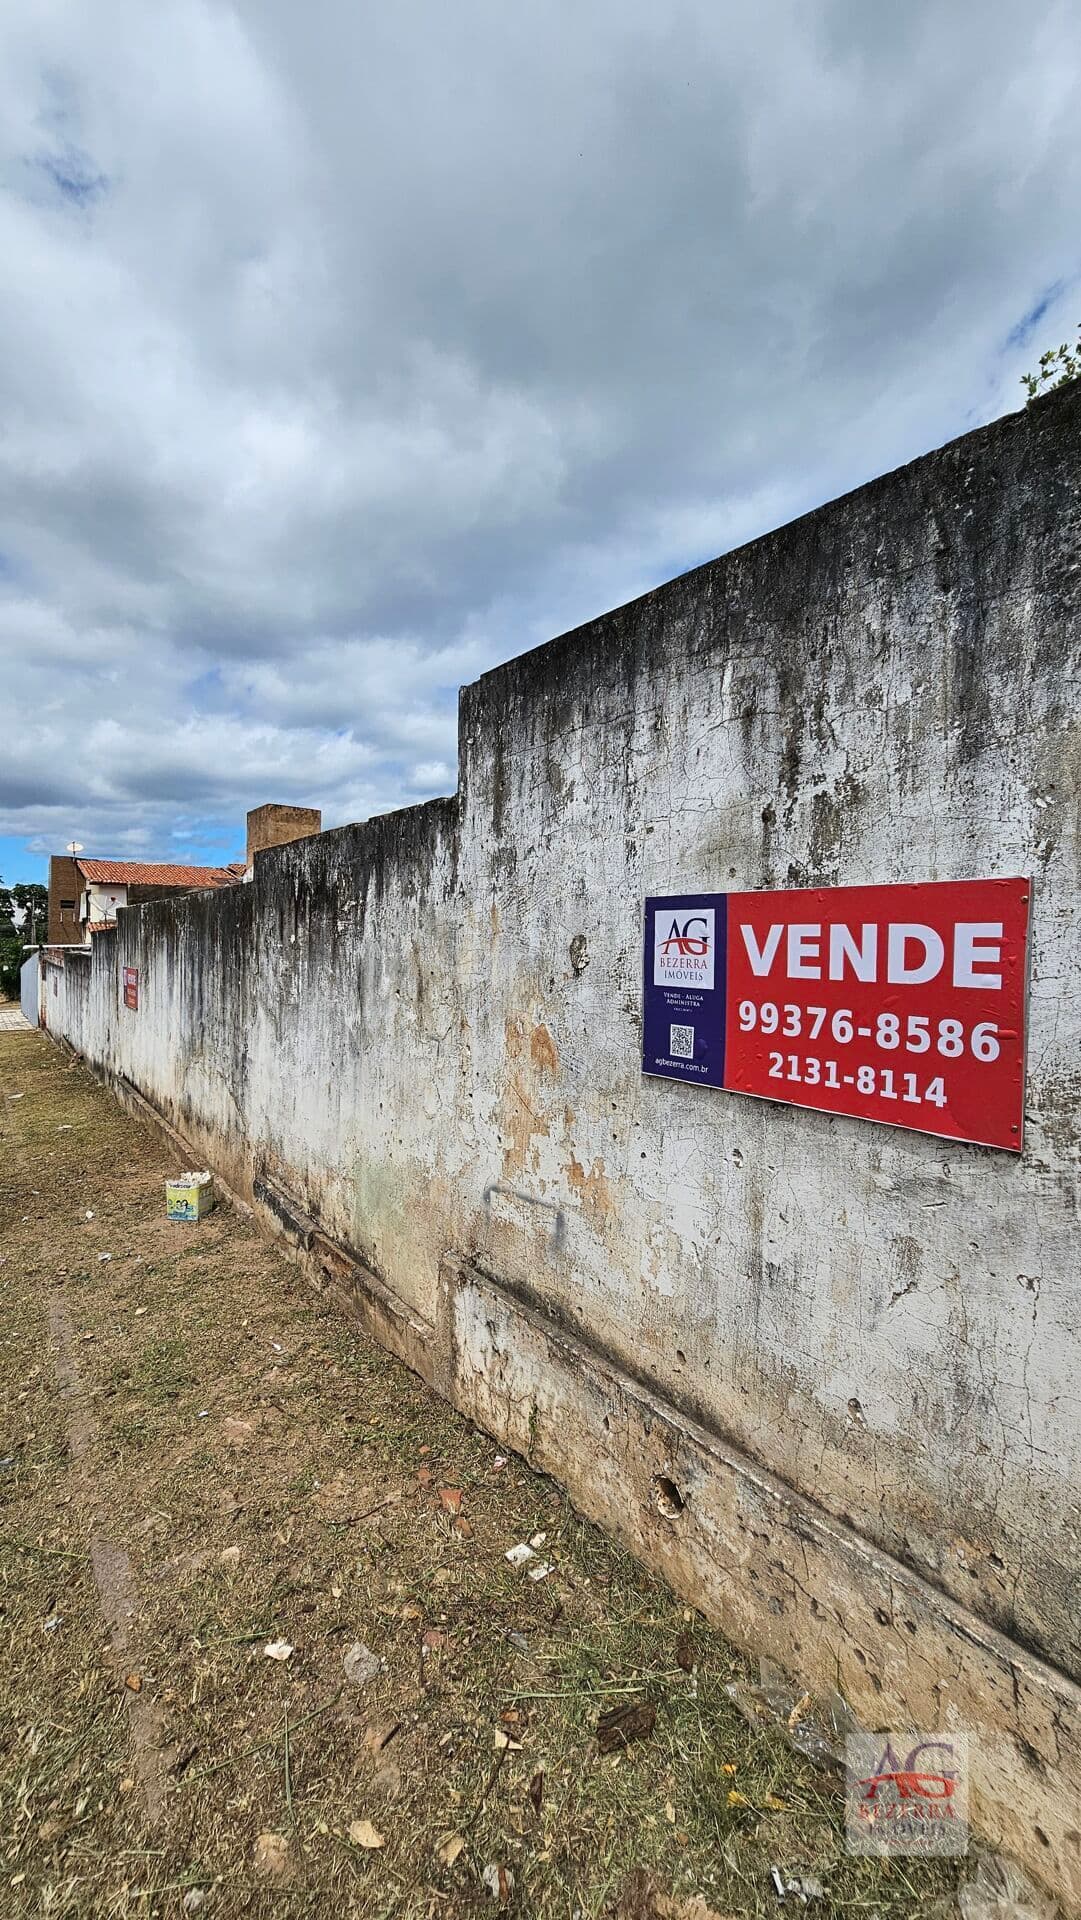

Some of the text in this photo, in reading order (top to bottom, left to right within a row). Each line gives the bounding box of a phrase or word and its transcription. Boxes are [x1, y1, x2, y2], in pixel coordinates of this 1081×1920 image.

[659, 917, 710, 956] AG
[740, 922, 1004, 990] VENDE
[660, 957, 708, 970] BEZERRA
[738, 1000, 1001, 1062] 99376-8586
[655, 1058, 709, 1073] agbezerra.com.br
[768, 1051, 948, 1108] 2131-8114
